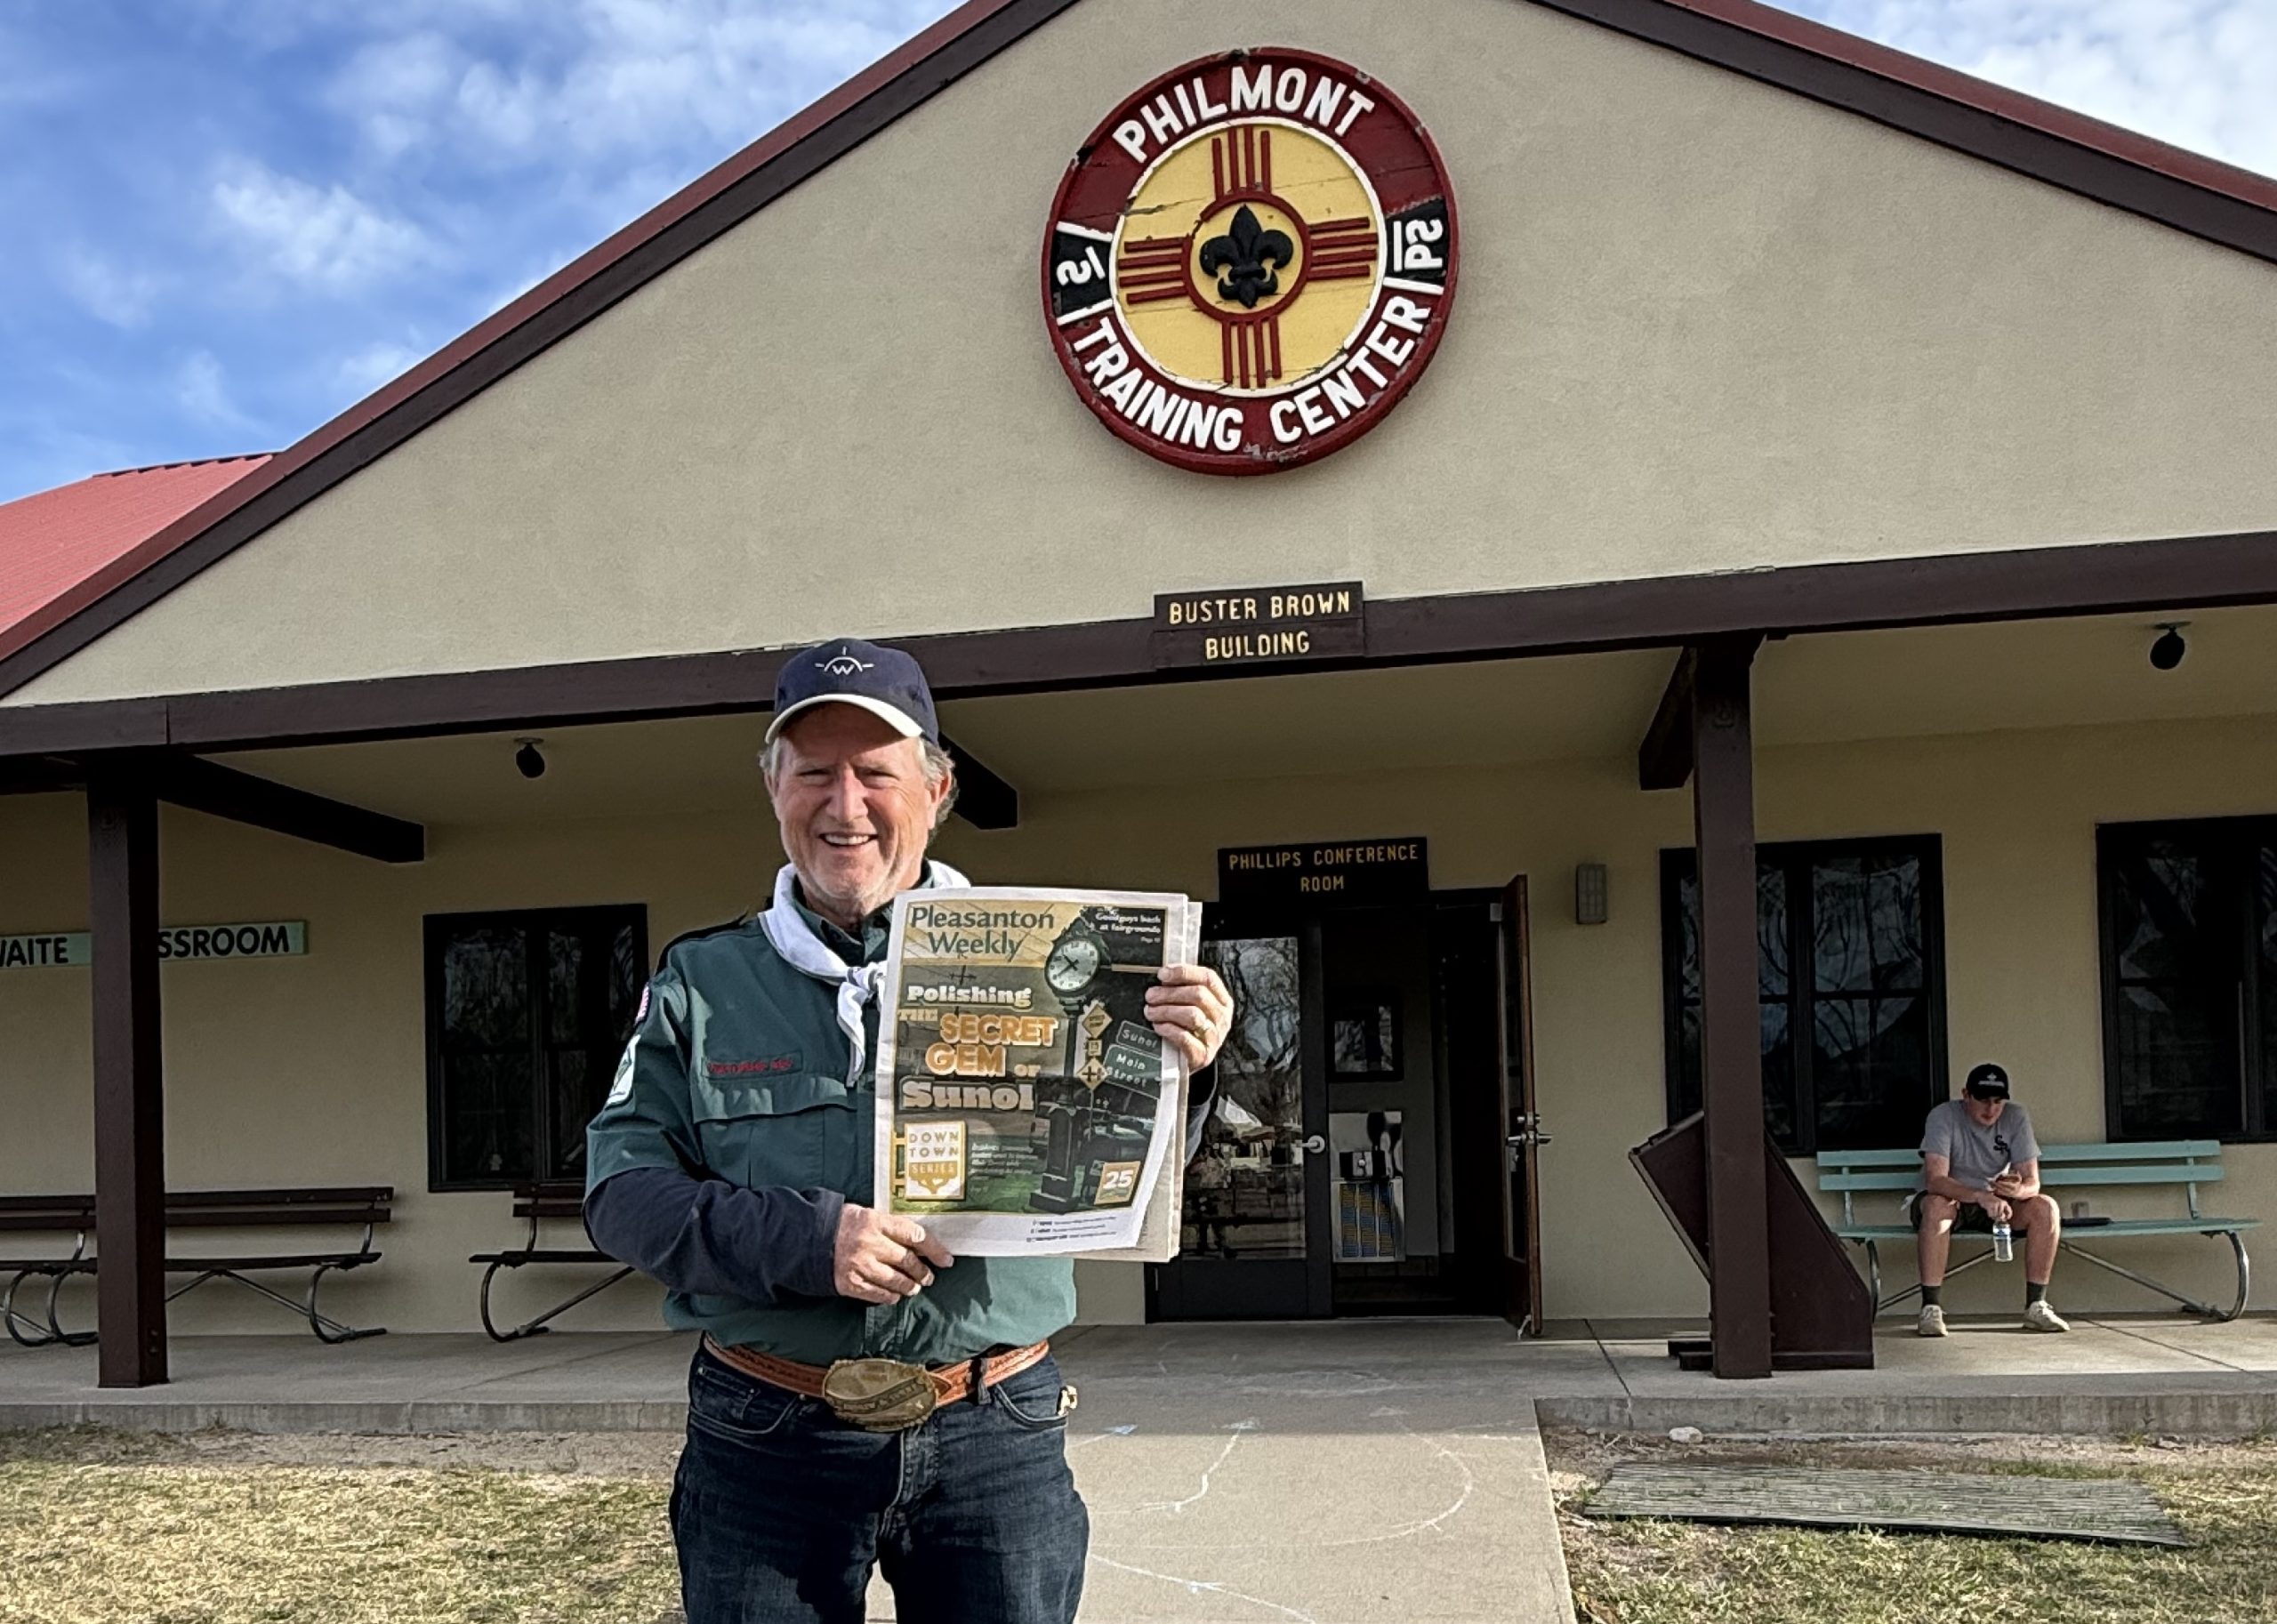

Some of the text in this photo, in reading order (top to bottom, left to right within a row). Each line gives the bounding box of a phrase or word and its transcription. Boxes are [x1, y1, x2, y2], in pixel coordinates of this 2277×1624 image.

[1112, 65, 1374, 164] PHILMONT
[1071, 295, 1429, 452] TRAINING CENTER
[1170, 591, 1349, 624] BUSTER BROWN
[1205, 631, 1310, 660] BUILDING
[1228, 845, 1418, 871] PHILLIPS CONFERENCE
[1300, 875, 1345, 892] ROOM
[910, 904, 1054, 930] Pleasanton
[157, 926, 290, 959] SSROOM
[928, 931, 1022, 962] Weekly
[905, 985, 1033, 1009] Polishing
[897, 1008, 939, 1022] THE
[939, 1013, 1059, 1046] SECRET
[1122, 1029, 1158, 1048] Sunol
[925, 1043, 1007, 1077] GEM
[1115, 1053, 1147, 1070] Main
[900, 1081, 1035, 1111] Sunol
[909, 1131, 959, 1144] DOWN
[909, 1147, 959, 1158] TOWN
[912, 1163, 954, 1174] SERIES
[1103, 1170, 1134, 1189] 25
